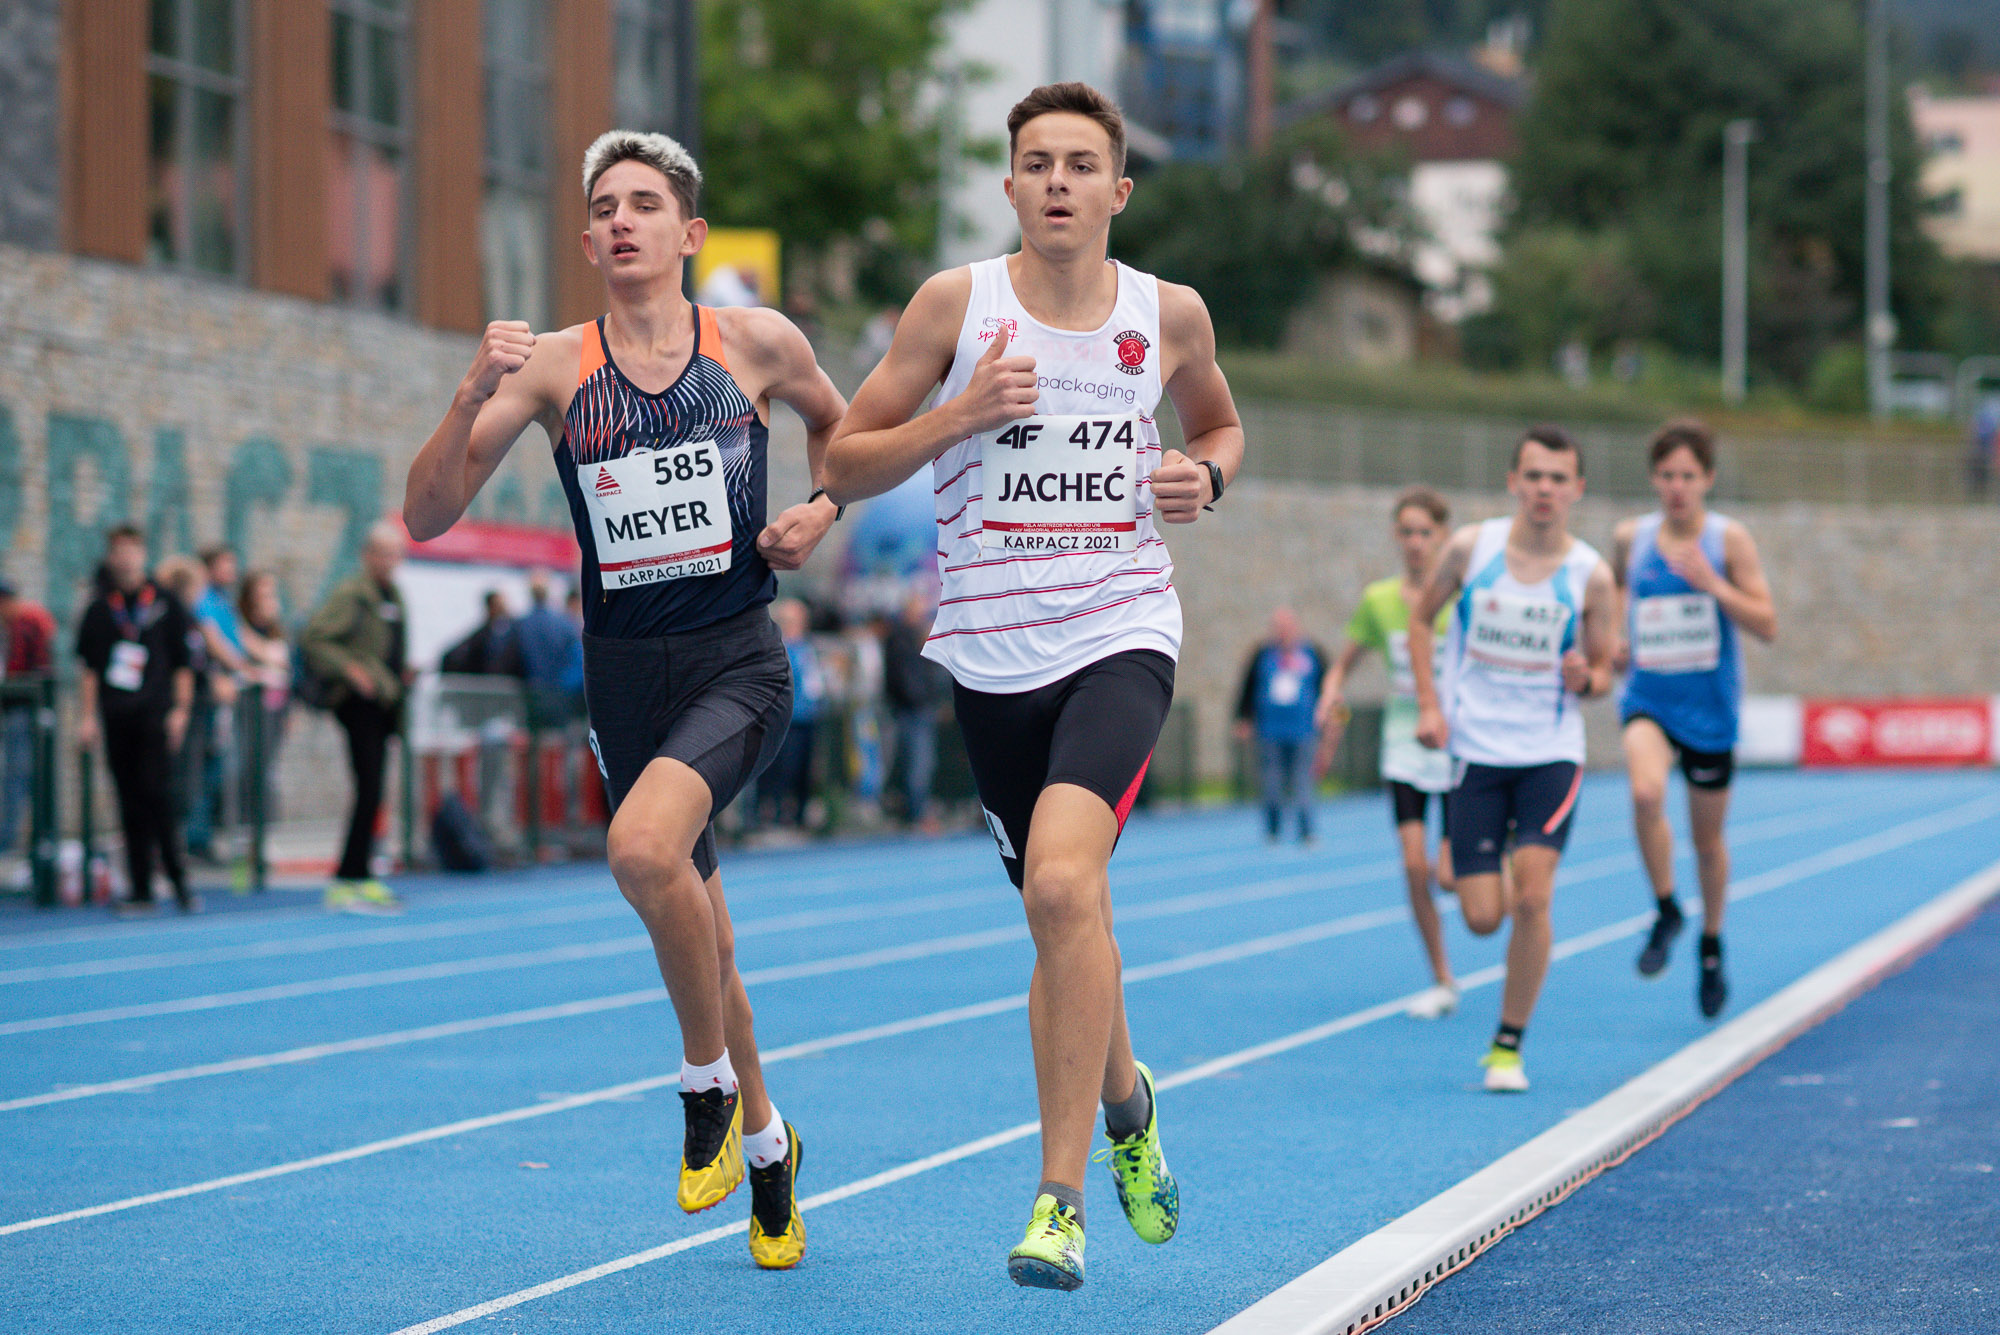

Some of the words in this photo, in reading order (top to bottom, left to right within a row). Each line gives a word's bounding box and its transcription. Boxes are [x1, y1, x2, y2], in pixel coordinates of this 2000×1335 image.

[1114, 331, 1149, 347] KOTWICA
[1117, 363, 1142, 375] BRZEG
[1037, 376, 1136, 404] packaging
[1068, 420, 1134, 450] 474
[654, 448, 714, 486] 585
[595, 489, 623, 498] KARPACZ
[998, 465, 1126, 502] JACHEĆ
[604, 500, 713, 544] MEYER
[1004, 535, 1079, 549] KARPACZ
[1084, 535, 1120, 549] 2021
[618, 565, 686, 586] KARPACZ
[688, 557, 722, 575] 2021
